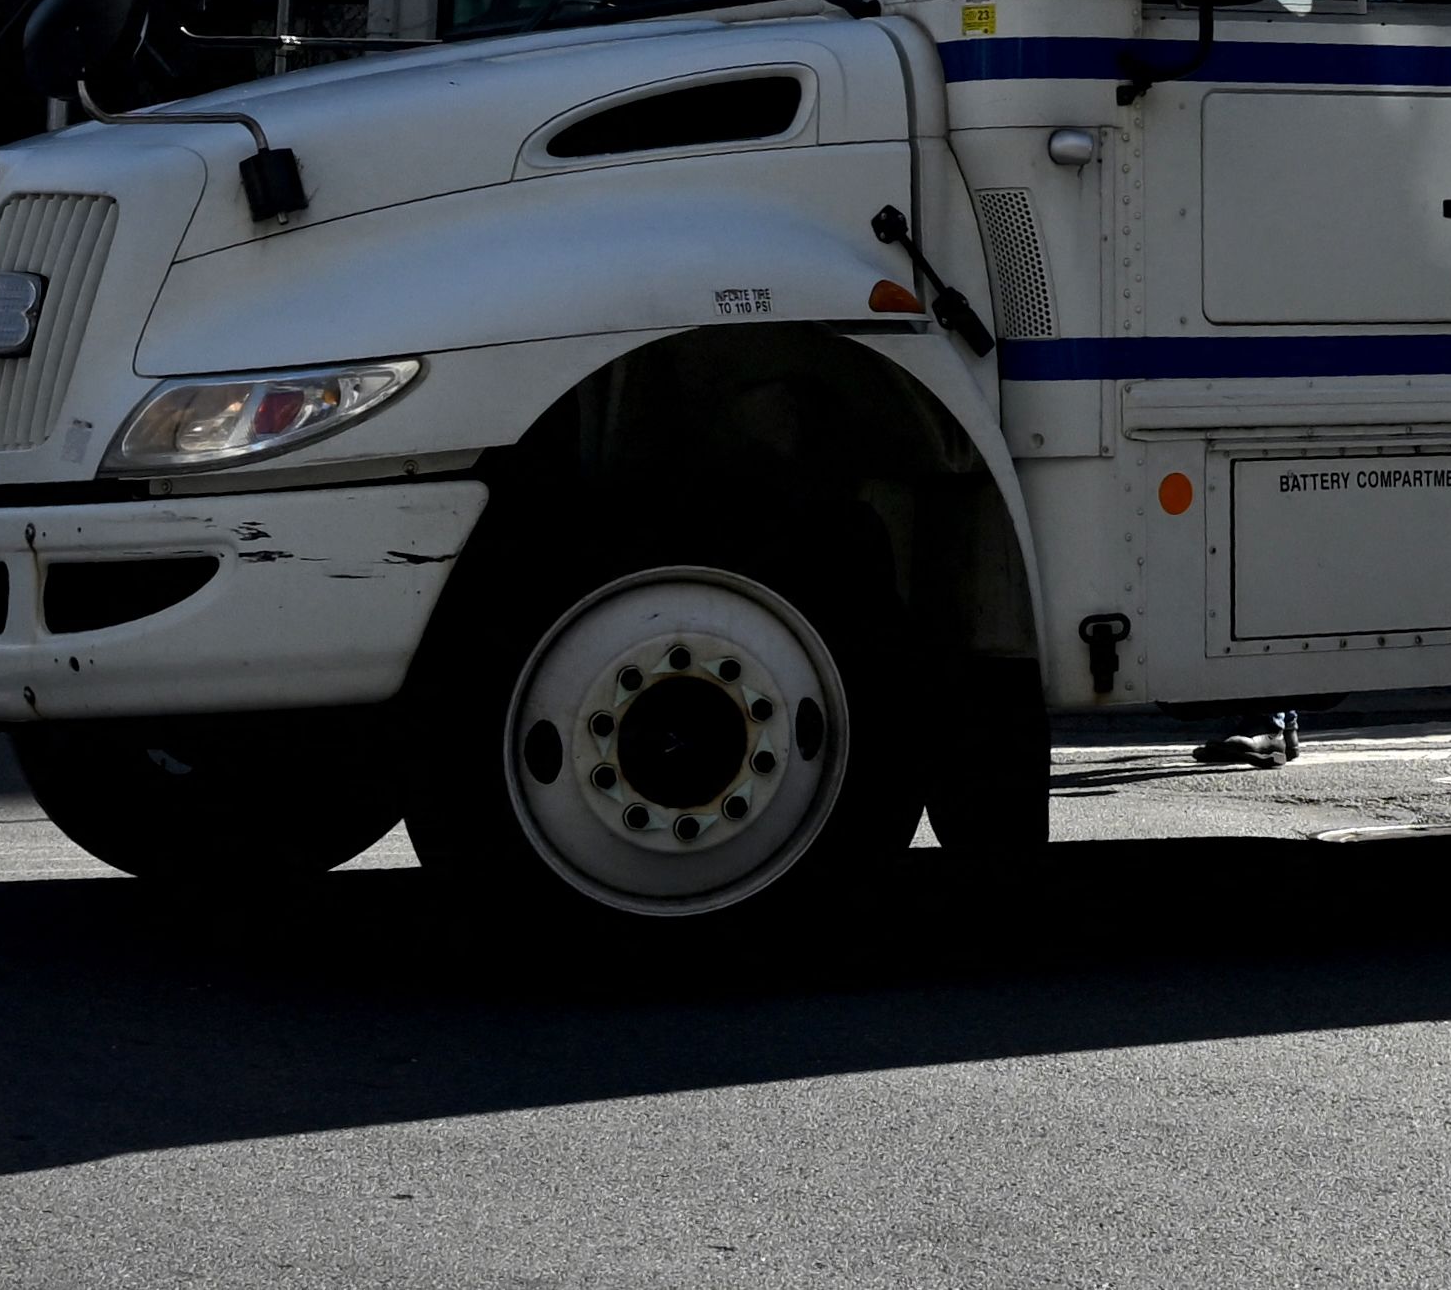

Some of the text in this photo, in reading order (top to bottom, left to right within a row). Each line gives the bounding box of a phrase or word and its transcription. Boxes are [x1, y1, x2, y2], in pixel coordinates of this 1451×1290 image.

[718, 300, 772, 314] TO 110 PSI
[1279, 472, 1350, 493] BATTERY
